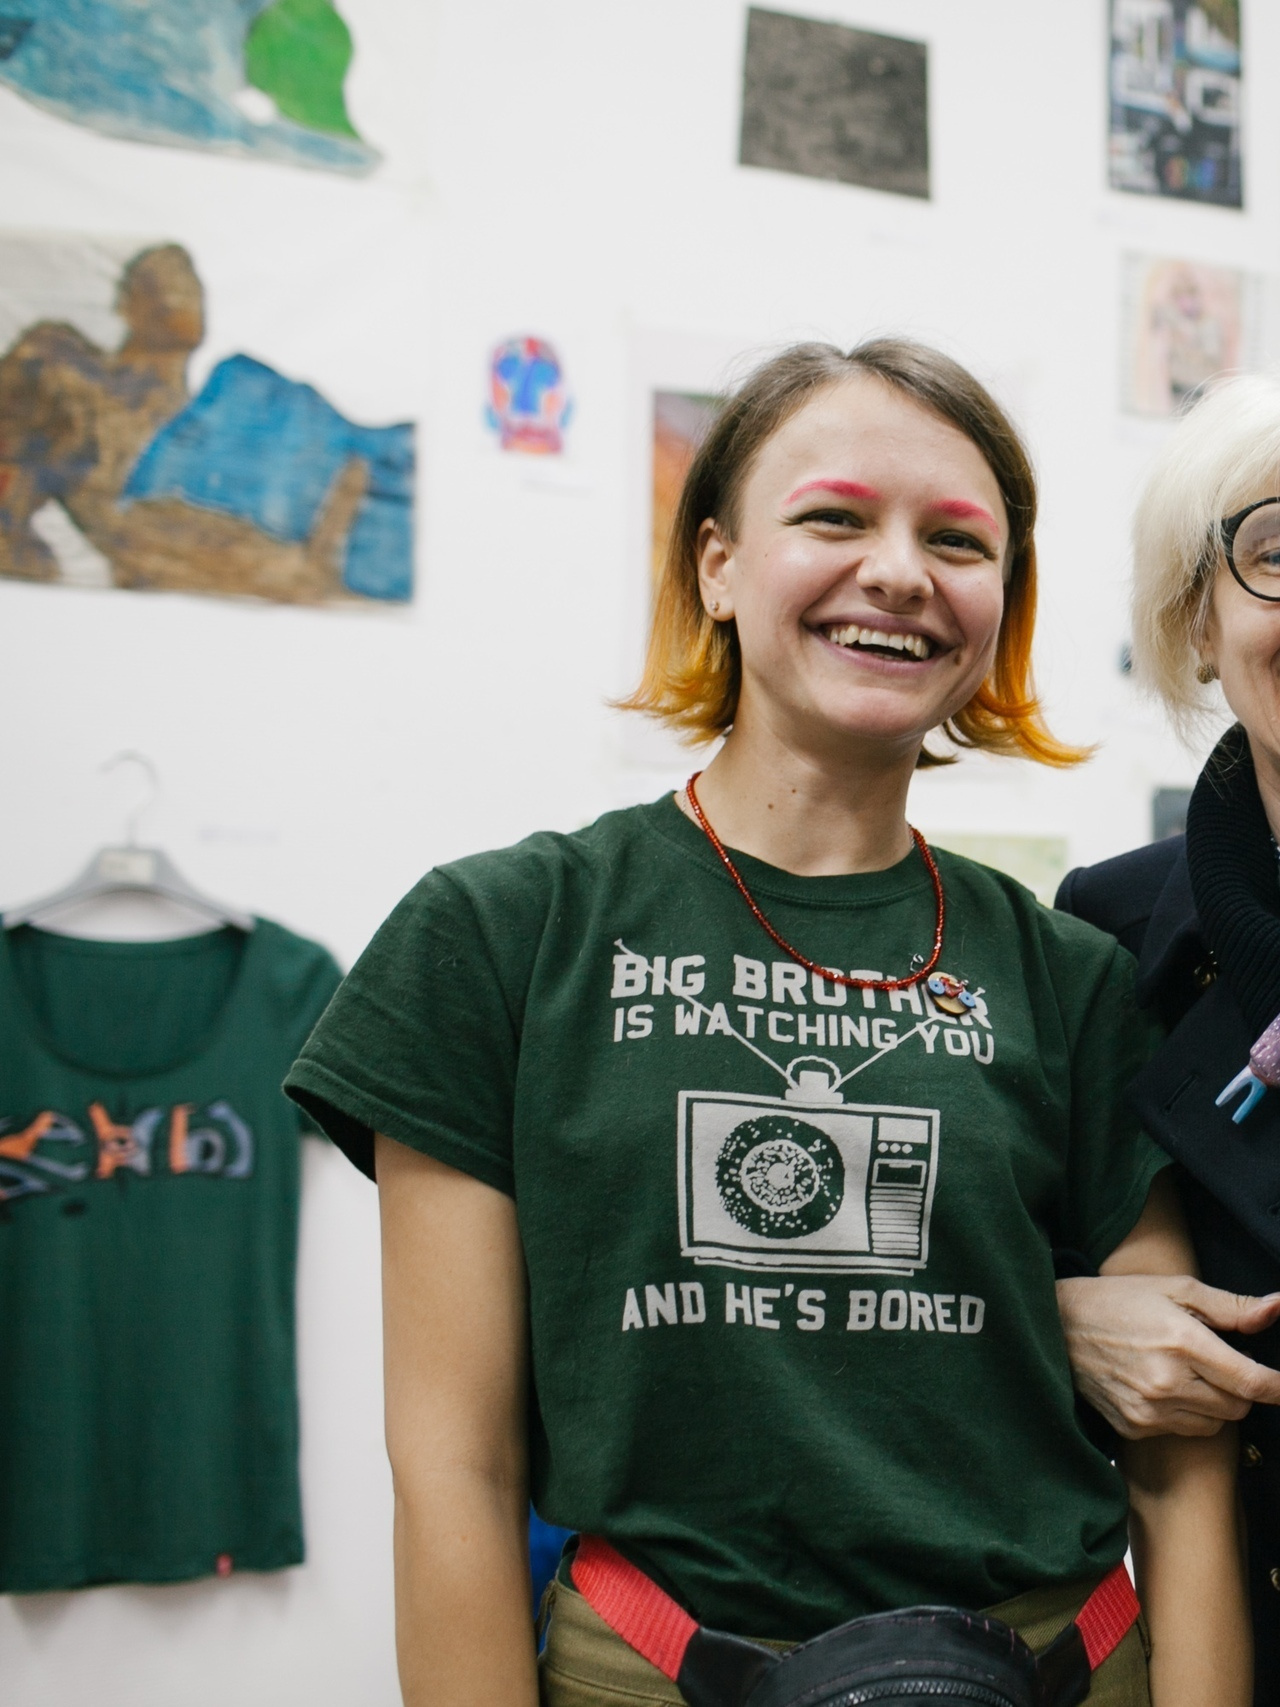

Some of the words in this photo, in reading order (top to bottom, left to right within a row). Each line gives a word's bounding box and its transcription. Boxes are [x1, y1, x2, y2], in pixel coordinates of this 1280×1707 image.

[611, 954, 706, 999] BIG
[613, 1004, 655, 1043] IS
[674, 1002, 899, 1050] WATCHING
[915, 1022, 995, 1065] YOU
[622, 1282, 706, 1333] AND
[725, 1282, 827, 1332] HE'S
[846, 1288, 986, 1334] BORED
